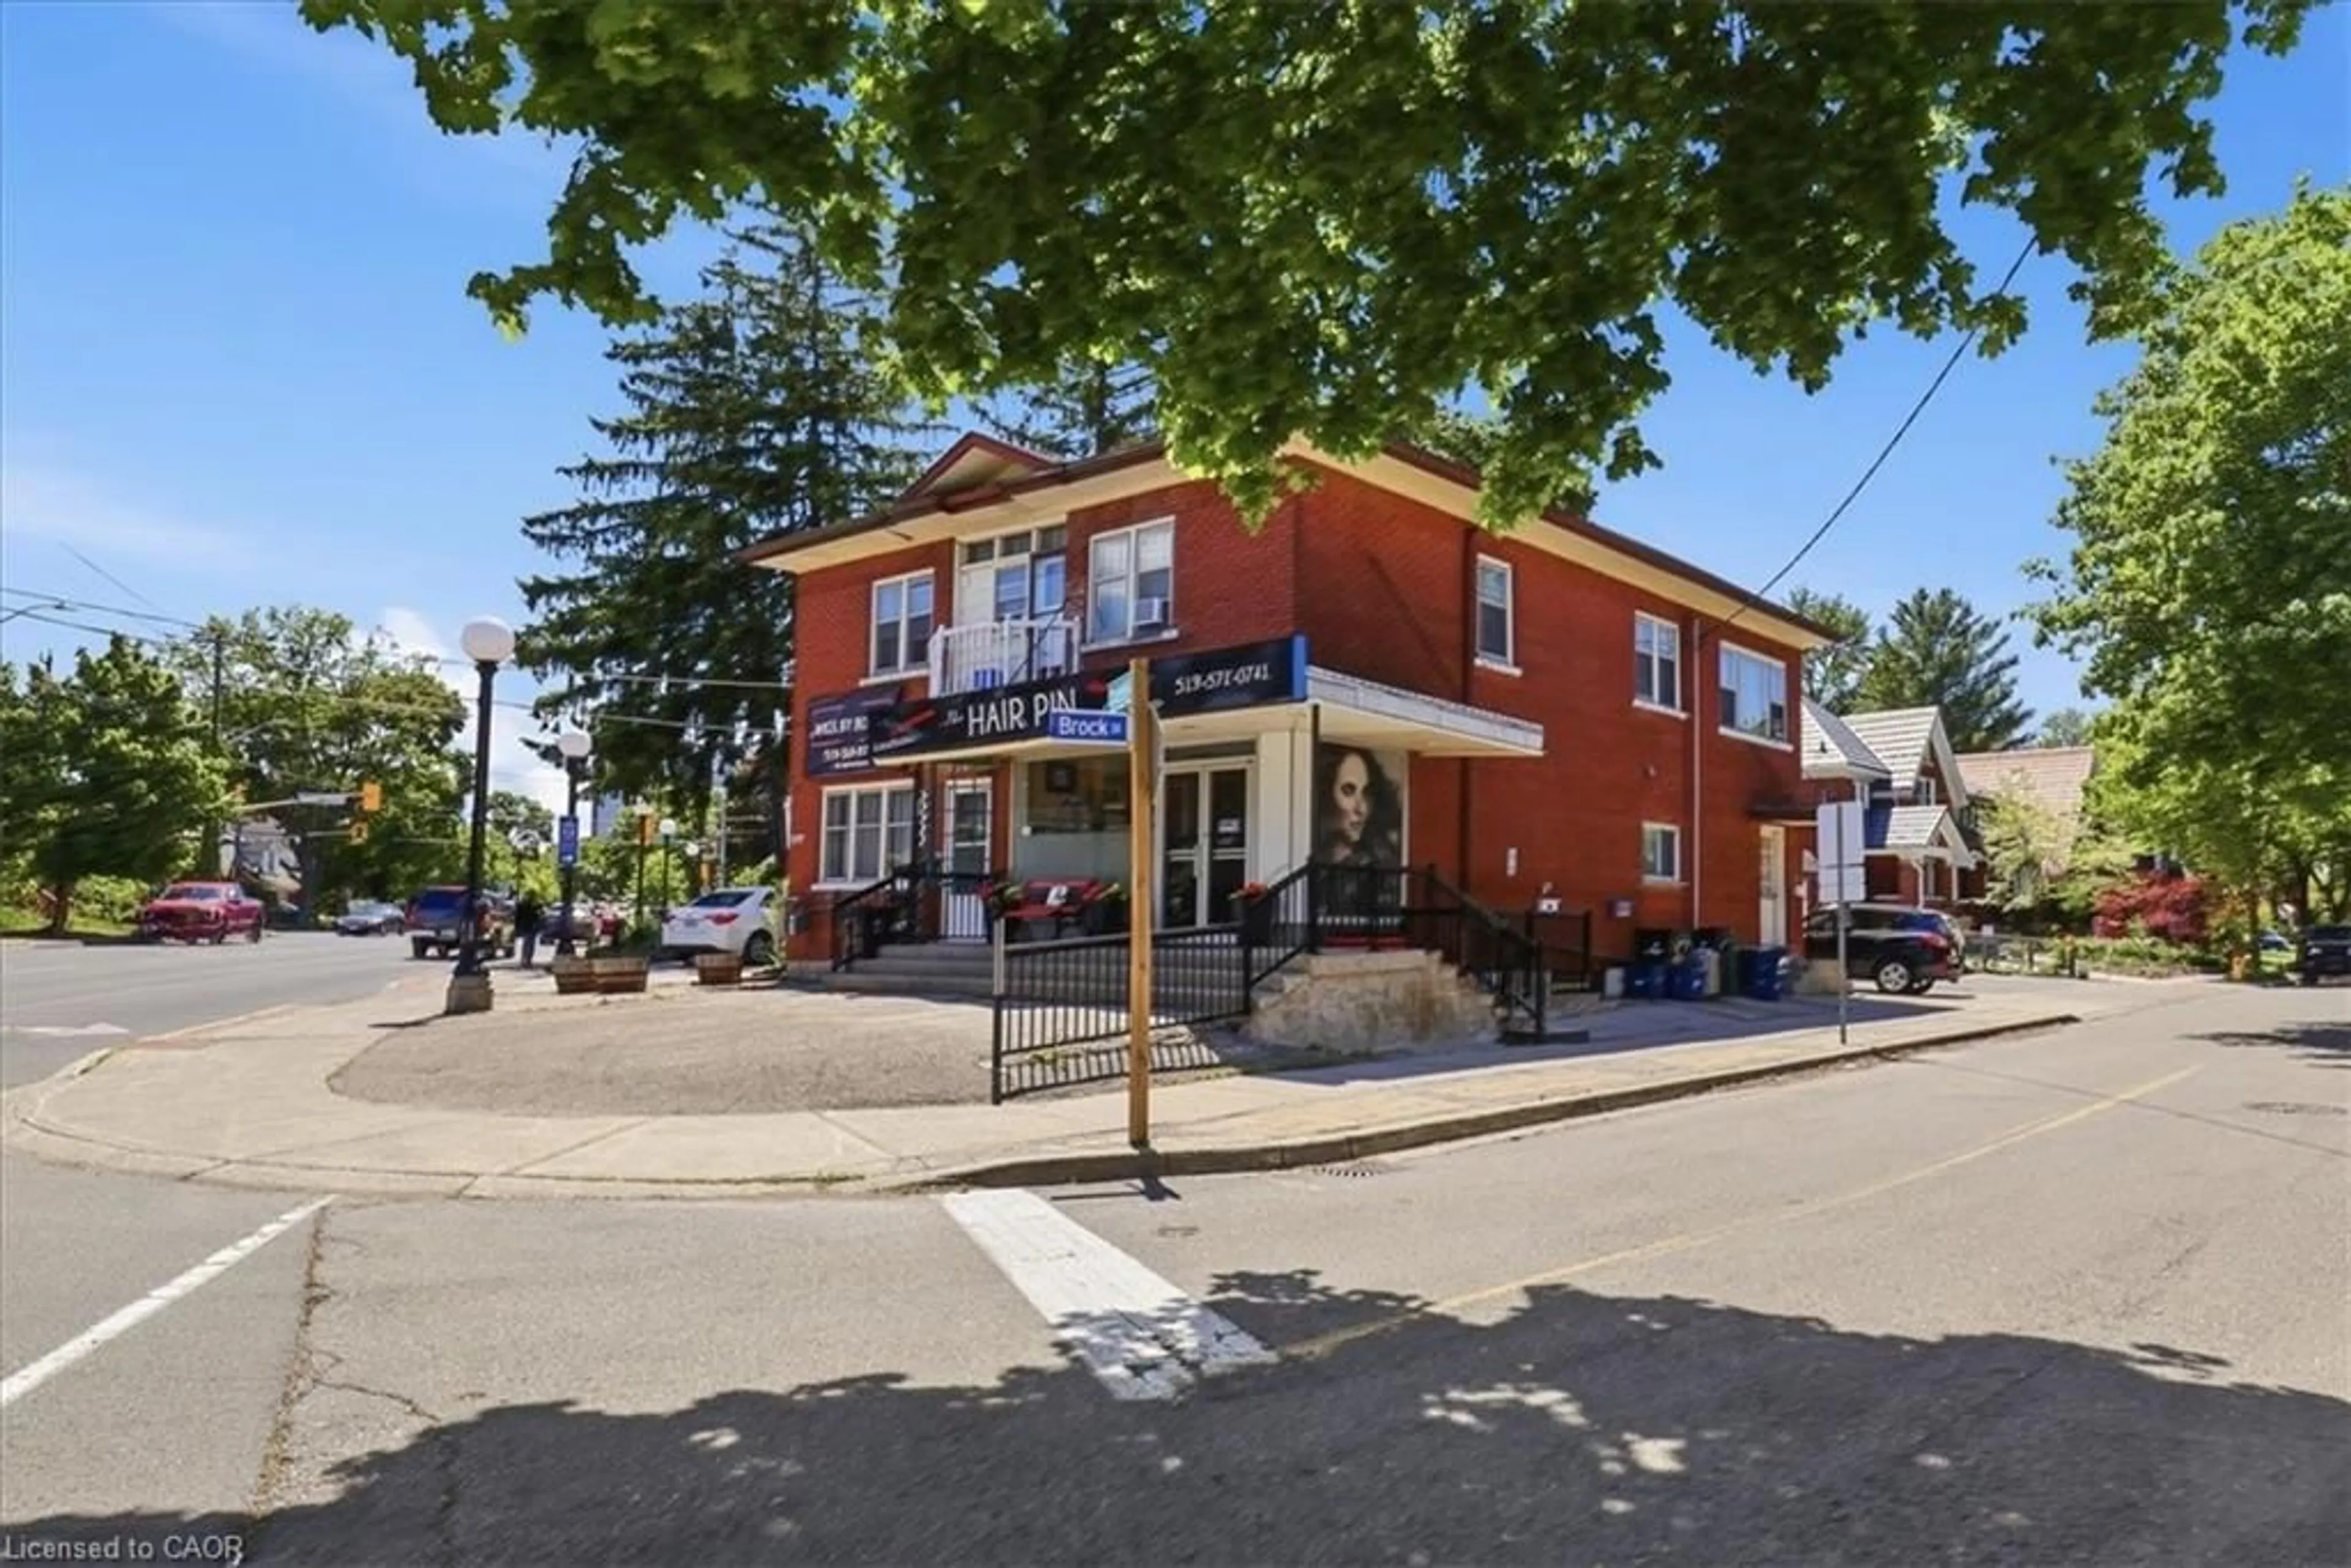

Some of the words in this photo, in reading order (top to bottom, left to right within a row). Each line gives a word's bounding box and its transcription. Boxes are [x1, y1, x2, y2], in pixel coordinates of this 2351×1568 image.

[967, 697, 1028, 737] HAIR
[1033, 687, 1076, 727] PIN
[1060, 715, 1108, 736] Brock
